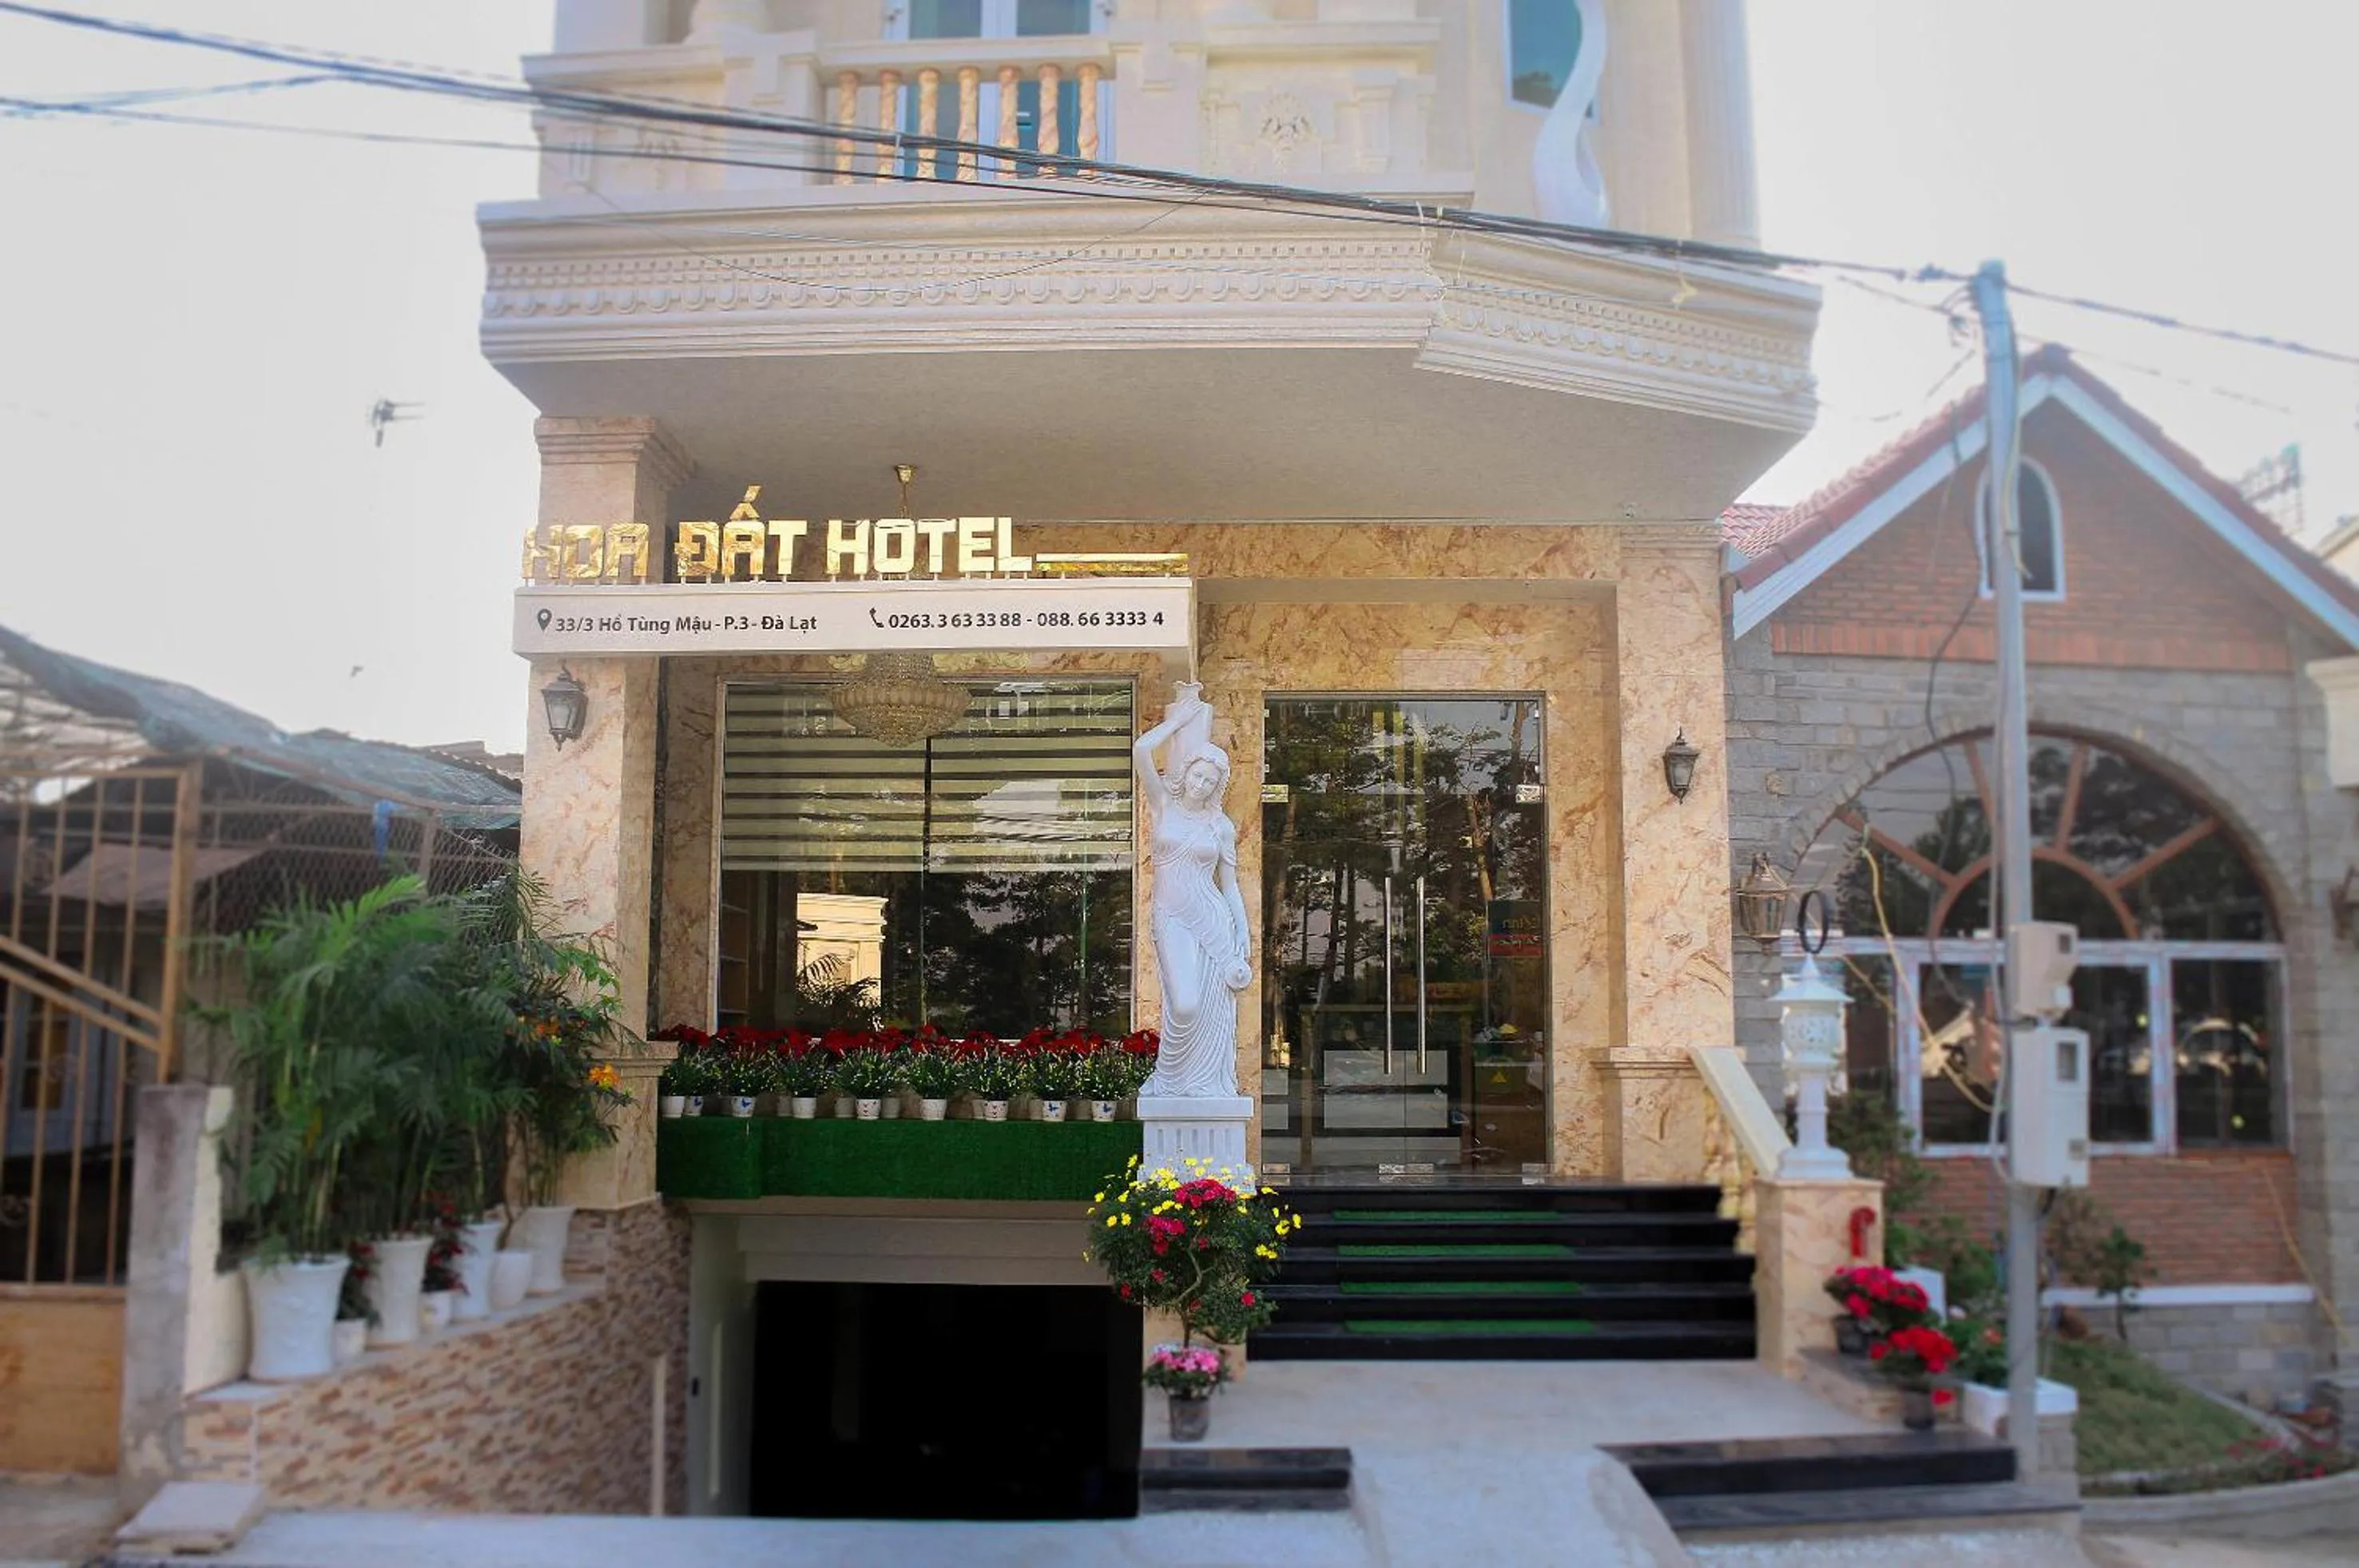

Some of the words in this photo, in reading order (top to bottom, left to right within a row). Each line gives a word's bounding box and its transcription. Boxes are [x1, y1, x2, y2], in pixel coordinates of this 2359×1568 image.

[522, 523, 649, 578] HOA
[674, 486, 808, 576] ĐẤT
[826, 517, 1032, 575] HOTEL
[554, 617, 594, 632] 33/3
[627, 616, 671, 635] Tùng
[789, 616, 817, 634] Lạt
